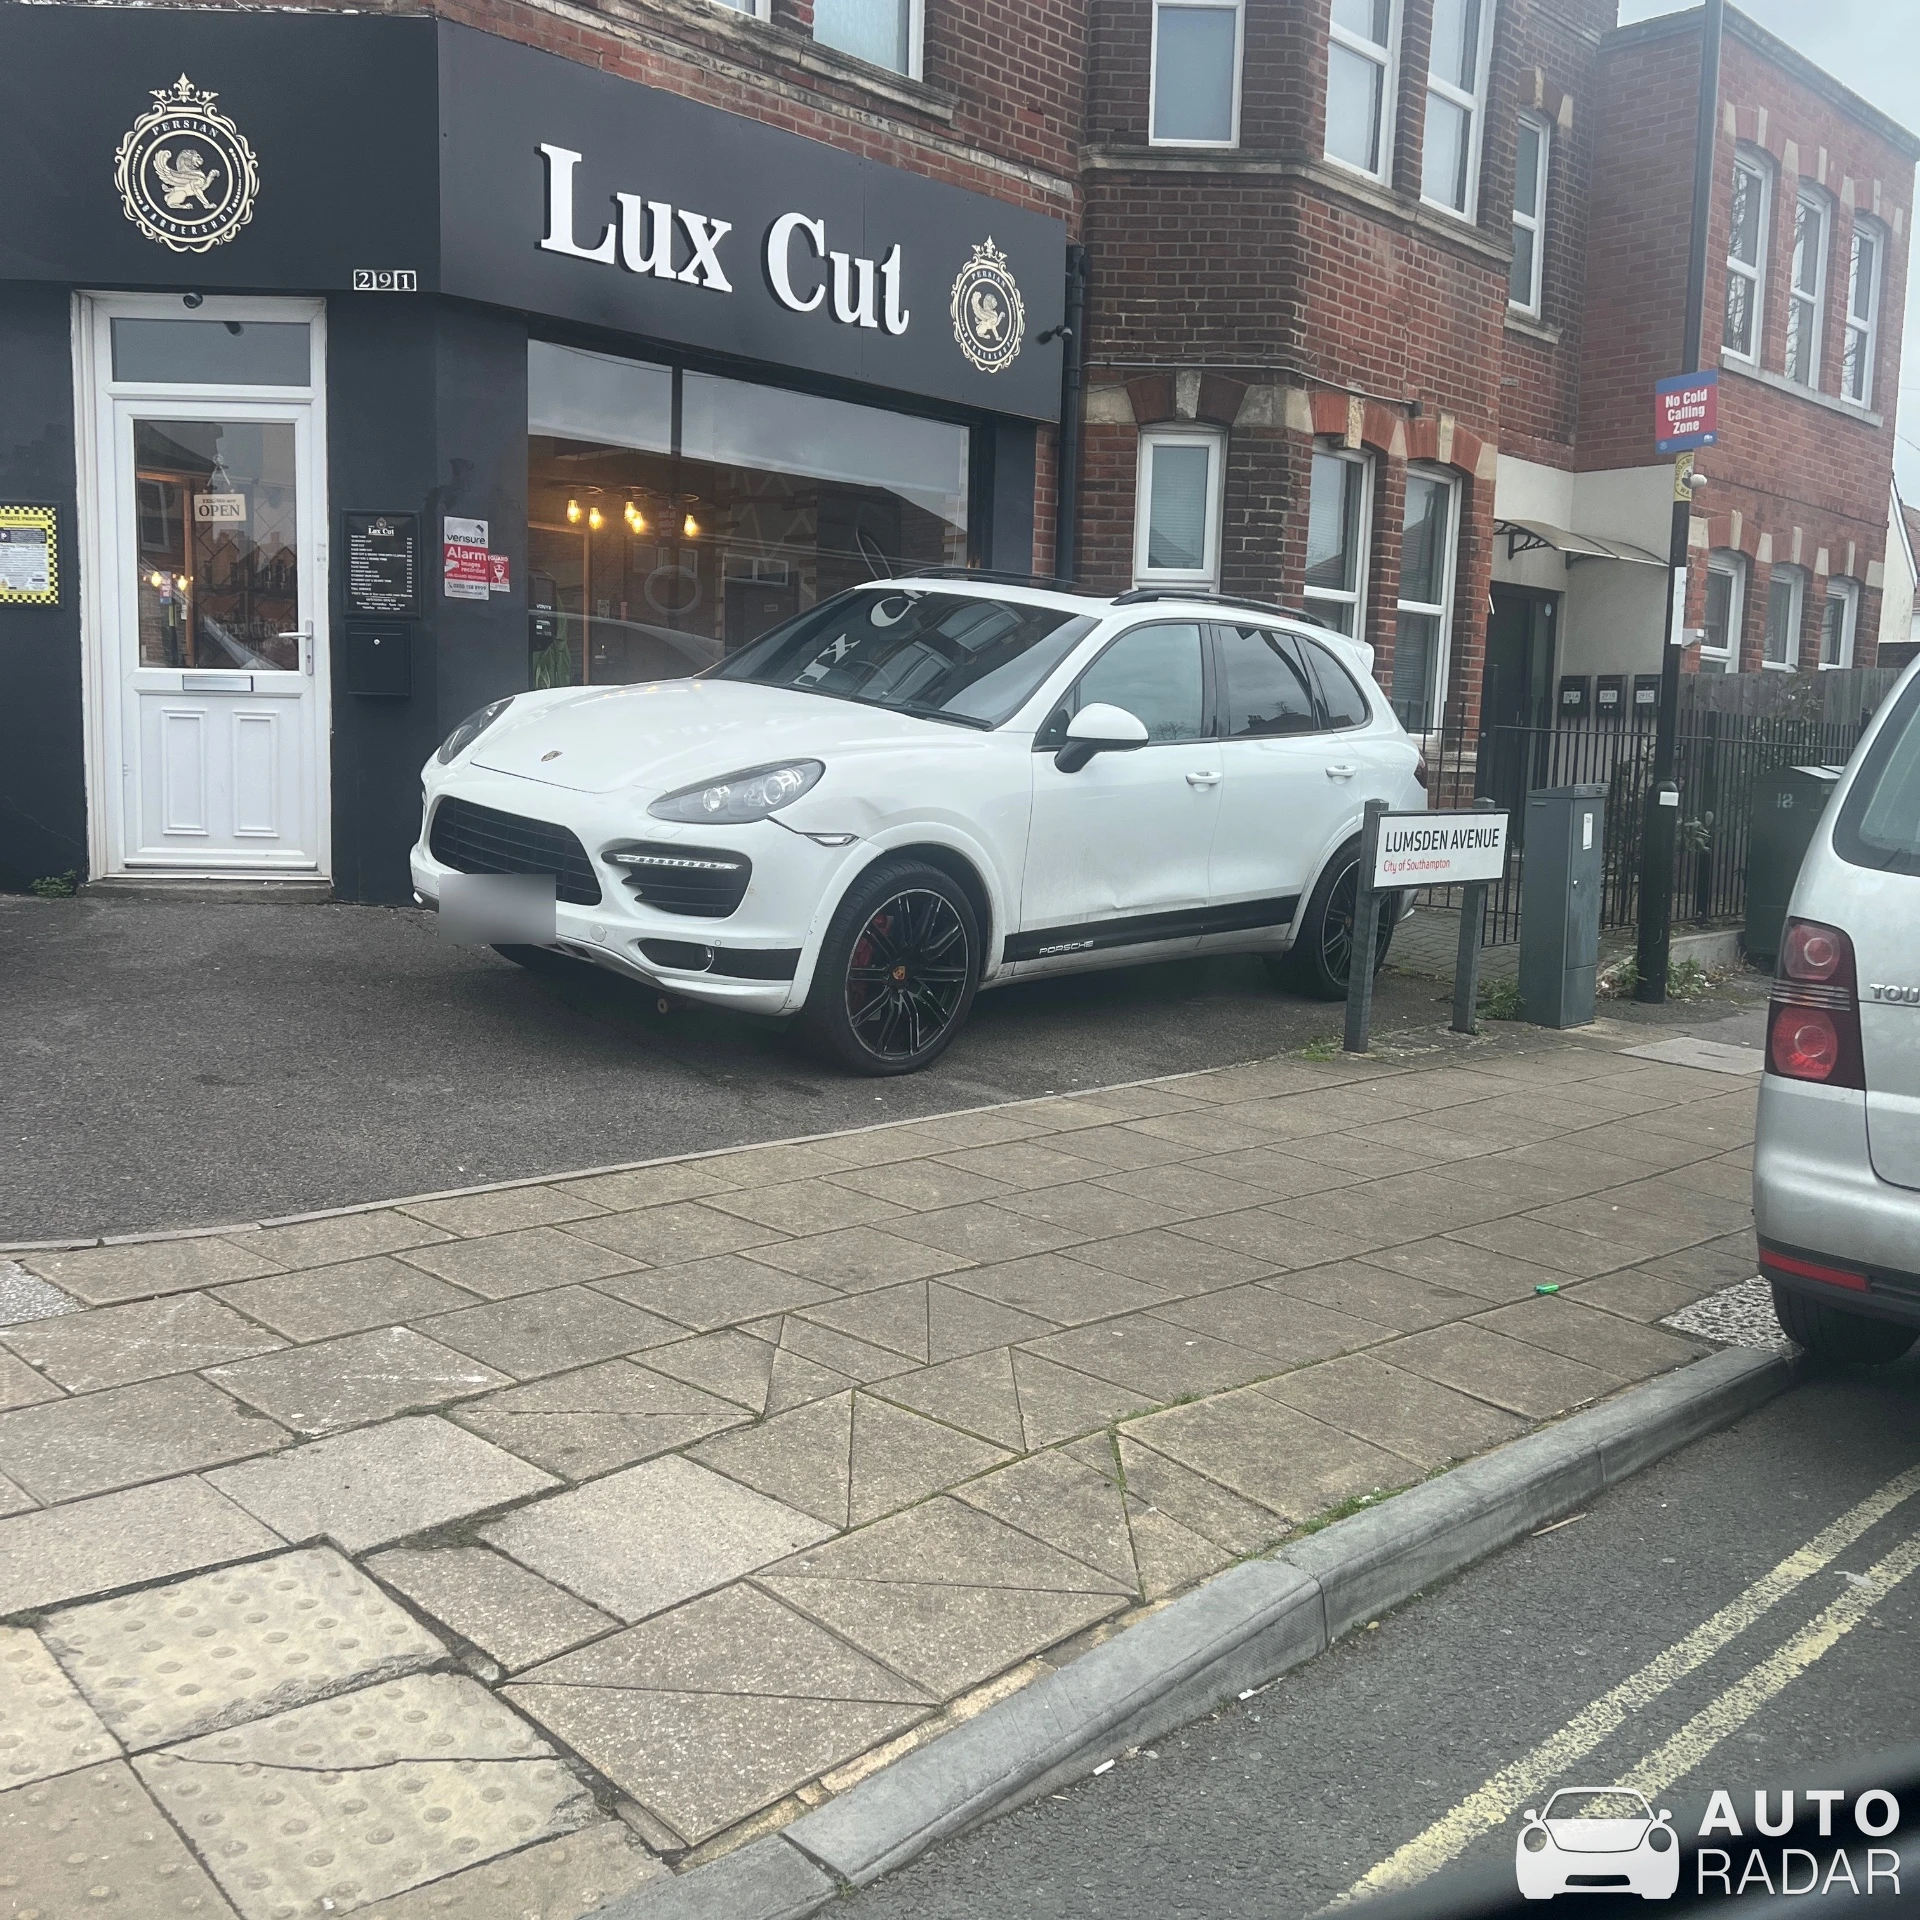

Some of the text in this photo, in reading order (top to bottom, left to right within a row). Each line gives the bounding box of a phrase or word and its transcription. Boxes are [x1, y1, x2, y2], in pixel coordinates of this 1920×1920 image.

[151, 120, 219, 138] PERSIAN
[141, 204, 234, 235] BARBERSHOP
[540, 142, 910, 335] Lux Cut
[358, 272, 410, 290] 291
[971, 270, 1006, 288] PERSIAN
[1665, 389, 1707, 408] No Cold
[1668, 405, 1705, 421] Calling
[1673, 420, 1700, 435] Zone
[199, 504, 240, 516] OPEN
[447, 534, 485, 544] verisure
[447, 546, 486, 561] Alarm
[1385, 828, 1499, 852] LUMSDEN AVENUE
[1384, 859, 1450, 874] City of Southampton
[1039, 940, 1094, 954] PORSCHE
